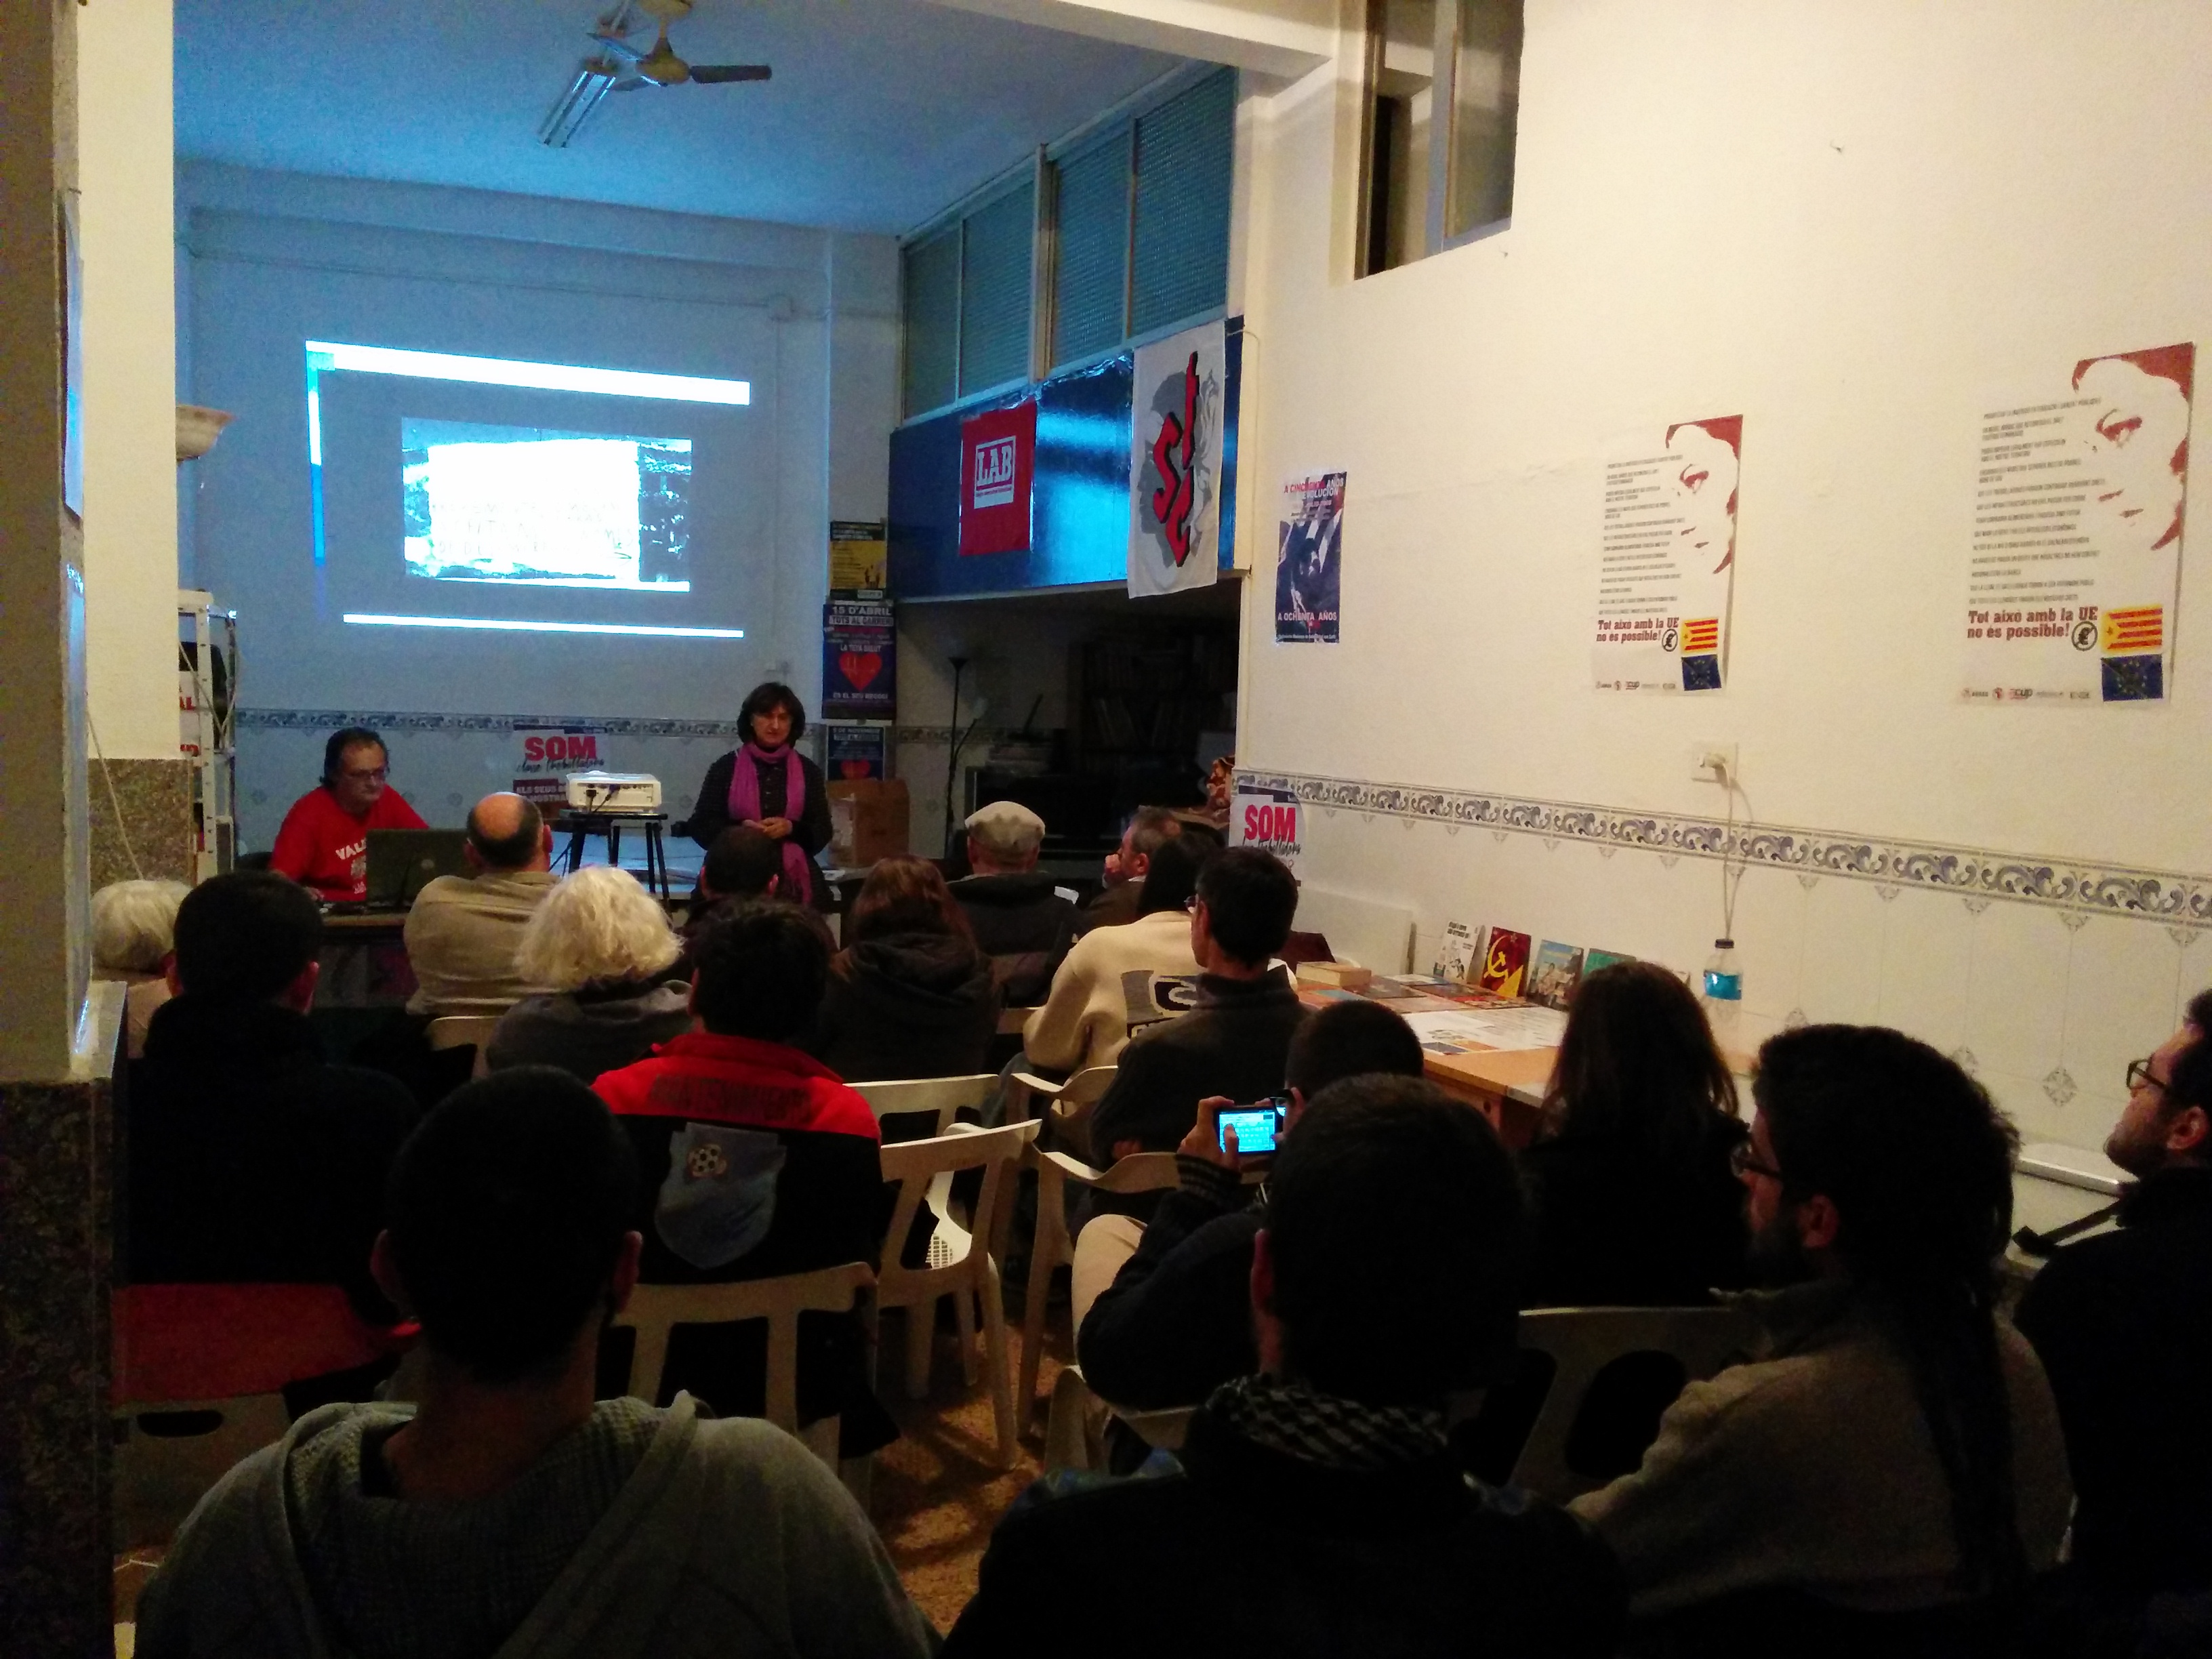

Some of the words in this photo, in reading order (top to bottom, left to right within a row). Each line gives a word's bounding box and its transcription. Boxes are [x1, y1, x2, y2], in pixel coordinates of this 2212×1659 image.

[977, 445, 1012, 487] LAB
[832, 606, 845, 615] 15
[848, 606, 892, 615] D'ABRIL
[1277, 613, 1283, 621] A
[1284, 611, 1315, 621] OCHENTA
[1318, 610, 1337, 621] AÑOS
[1967, 610, 1989, 623] Tot
[1993, 609, 2022, 623] això
[2026, 607, 2057, 622] amb
[2060, 607, 2074, 621] la
[2078, 606, 2099, 621] UE
[1597, 619, 1612, 630] Tot
[1634, 618, 1653, 629] amb
[1656, 617, 1664, 628] la
[1666, 617, 1679, 628] UE
[1967, 627, 1983, 638] no
[1986, 625, 2002, 638] és
[2006, 623, 2070, 641] possible!
[1596, 633, 1607, 642] no
[524, 735, 597, 762] SOM
[1244, 804, 1296, 843] SOM
